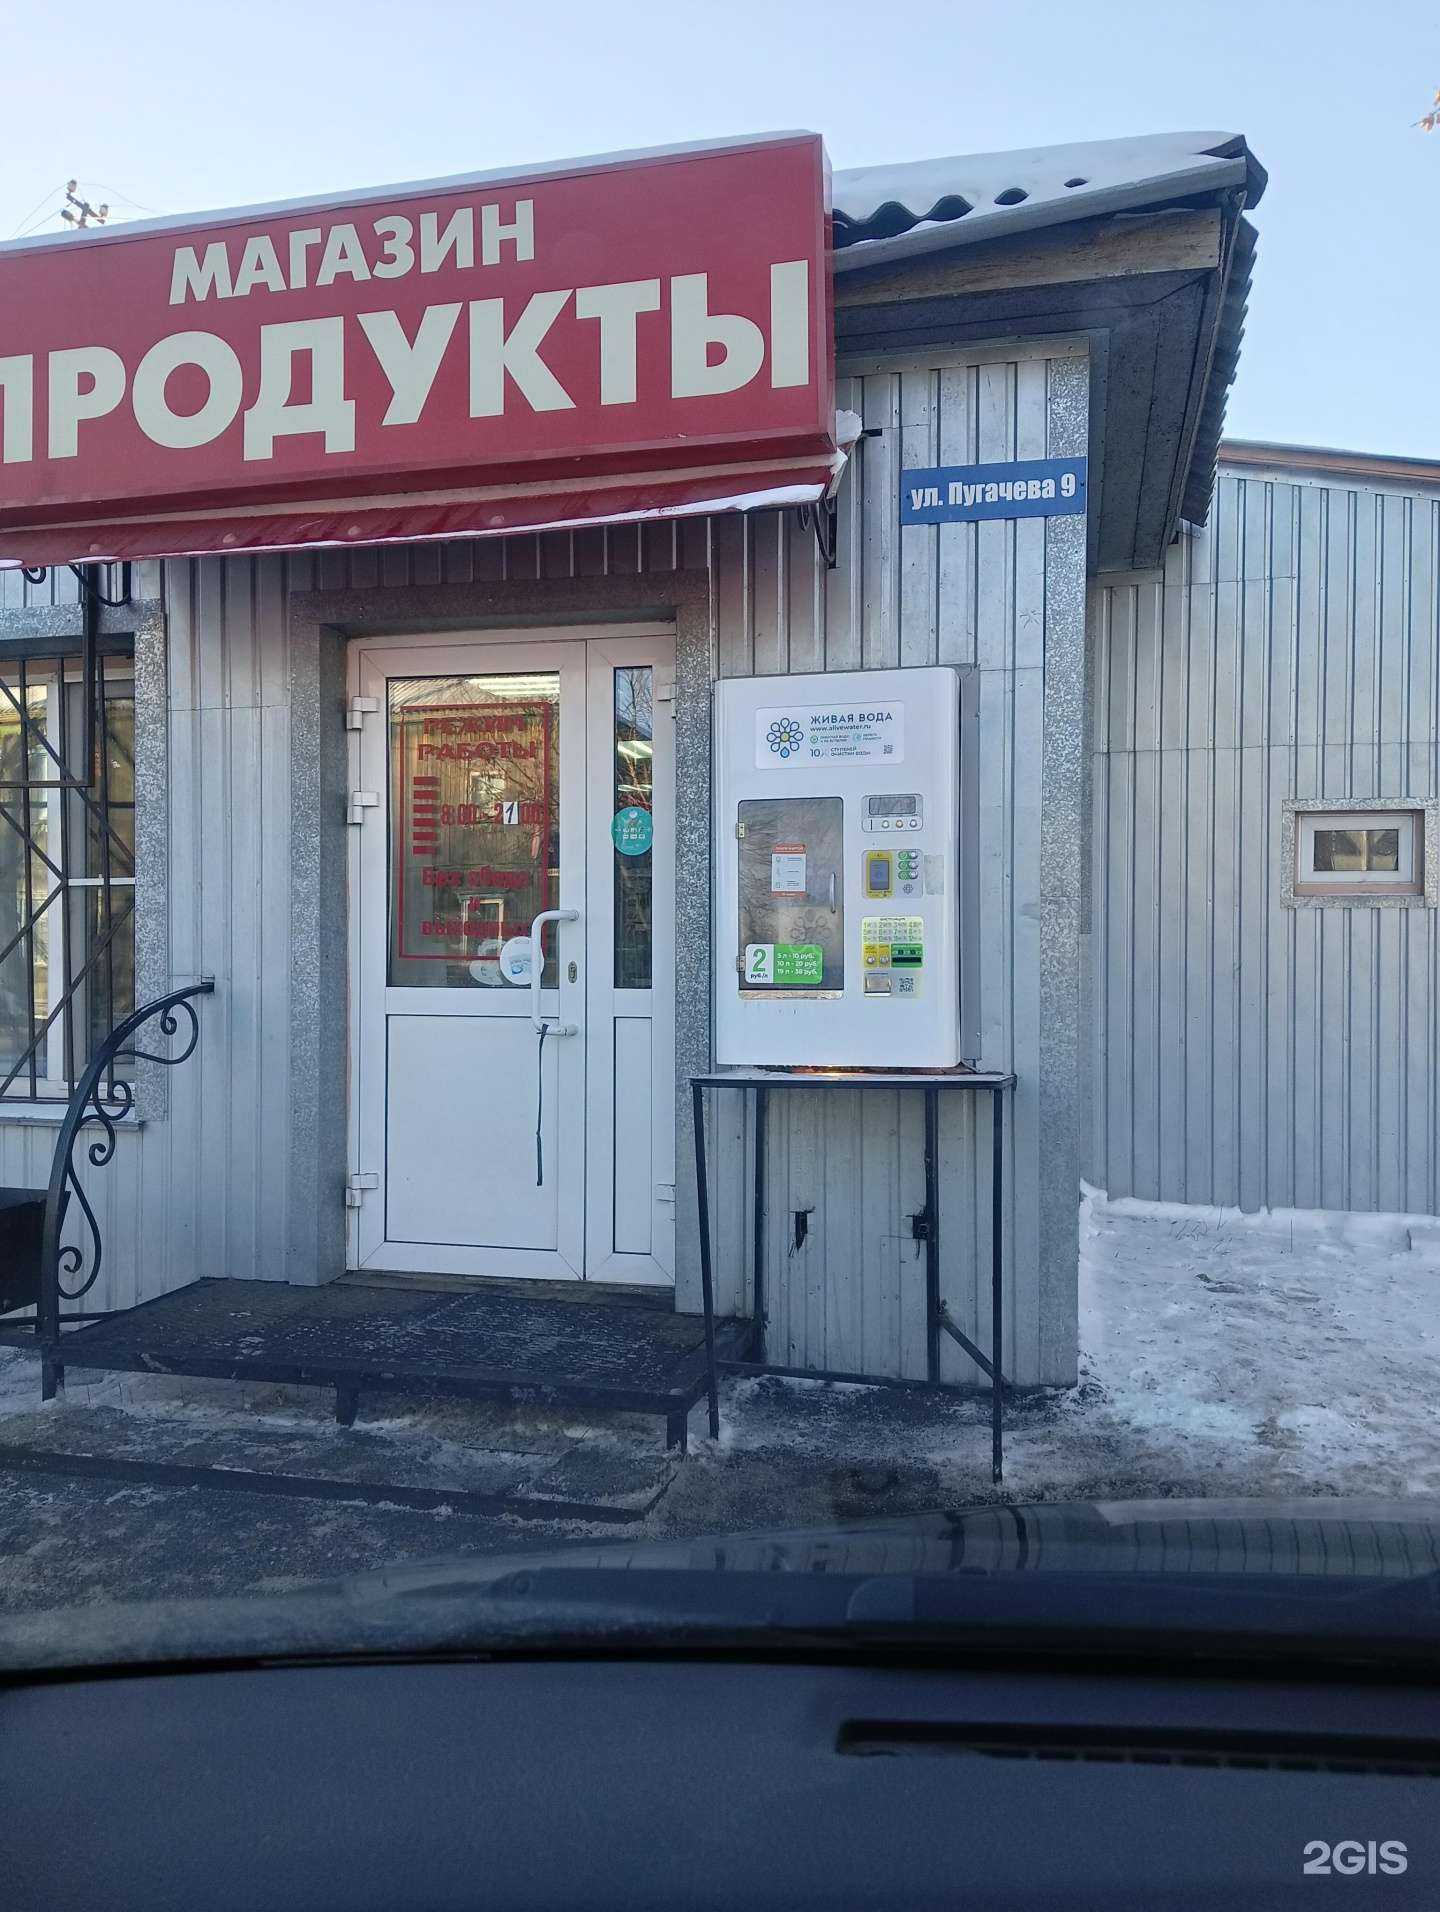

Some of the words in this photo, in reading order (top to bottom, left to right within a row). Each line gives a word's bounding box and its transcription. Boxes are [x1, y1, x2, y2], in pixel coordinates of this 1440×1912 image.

[168, 199, 535, 306] МАГАЗИН
[911, 488, 944, 510] ул.
[948, 478, 1046, 507] Пугачева
[1060, 473, 1076, 497] 9
[810, 714, 854, 724] ЖИВАЯ
[859, 712, 893, 723] ВОДА
[810, 724, 871, 732] www.alivewater.ru
[418, 740, 537, 760] РАБОТЫ
[752, 948, 767, 972] 2
